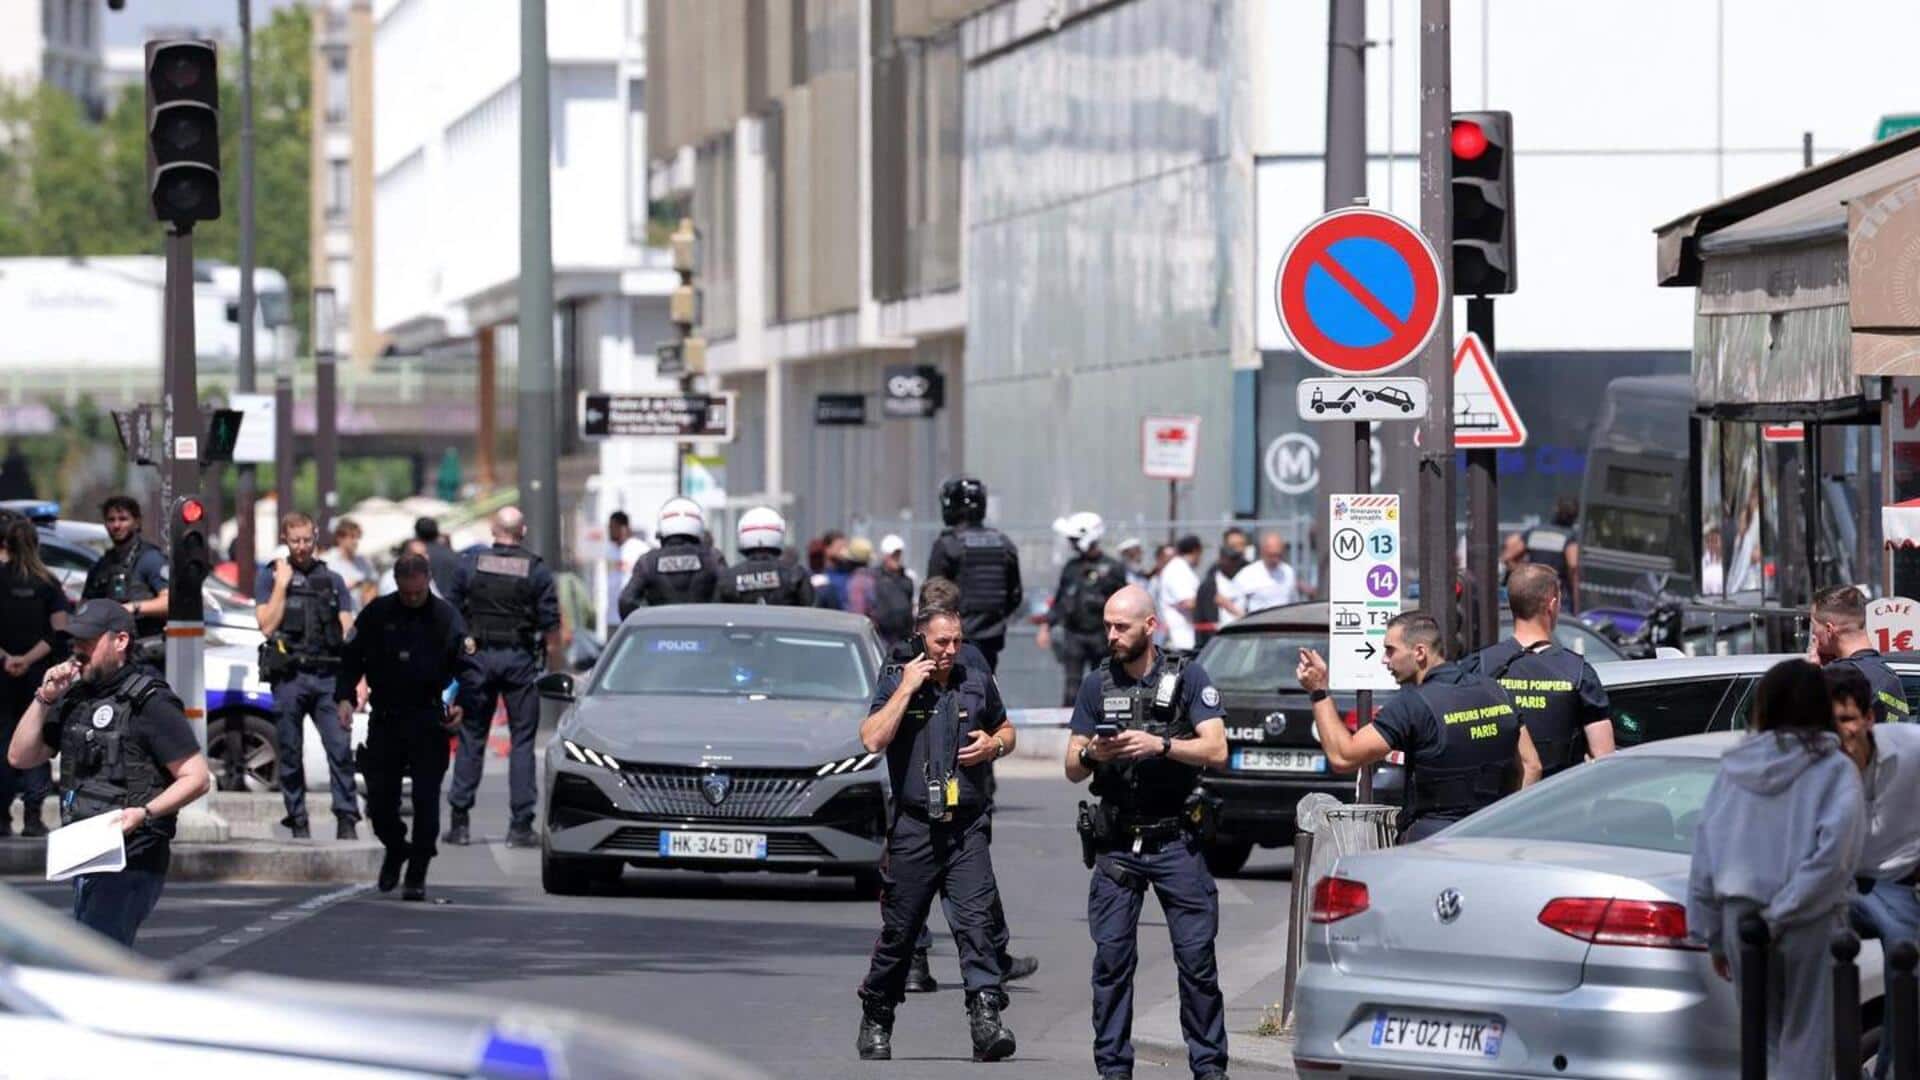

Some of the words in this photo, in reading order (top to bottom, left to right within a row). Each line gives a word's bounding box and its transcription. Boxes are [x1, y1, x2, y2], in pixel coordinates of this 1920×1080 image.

[1340, 535, 1357, 553] M
[1370, 535, 1393, 554] 13
[1370, 572, 1394, 591] 14
[657, 640, 697, 651] POLICE
[1529, 679, 1573, 691] POMPIERS
[1515, 695, 1546, 709] PARIS
[1444, 709, 1479, 724] SAPEURS
[1470, 723, 1498, 740] PARIS
[1384, 1016, 1488, 1052] EV-021-HK
